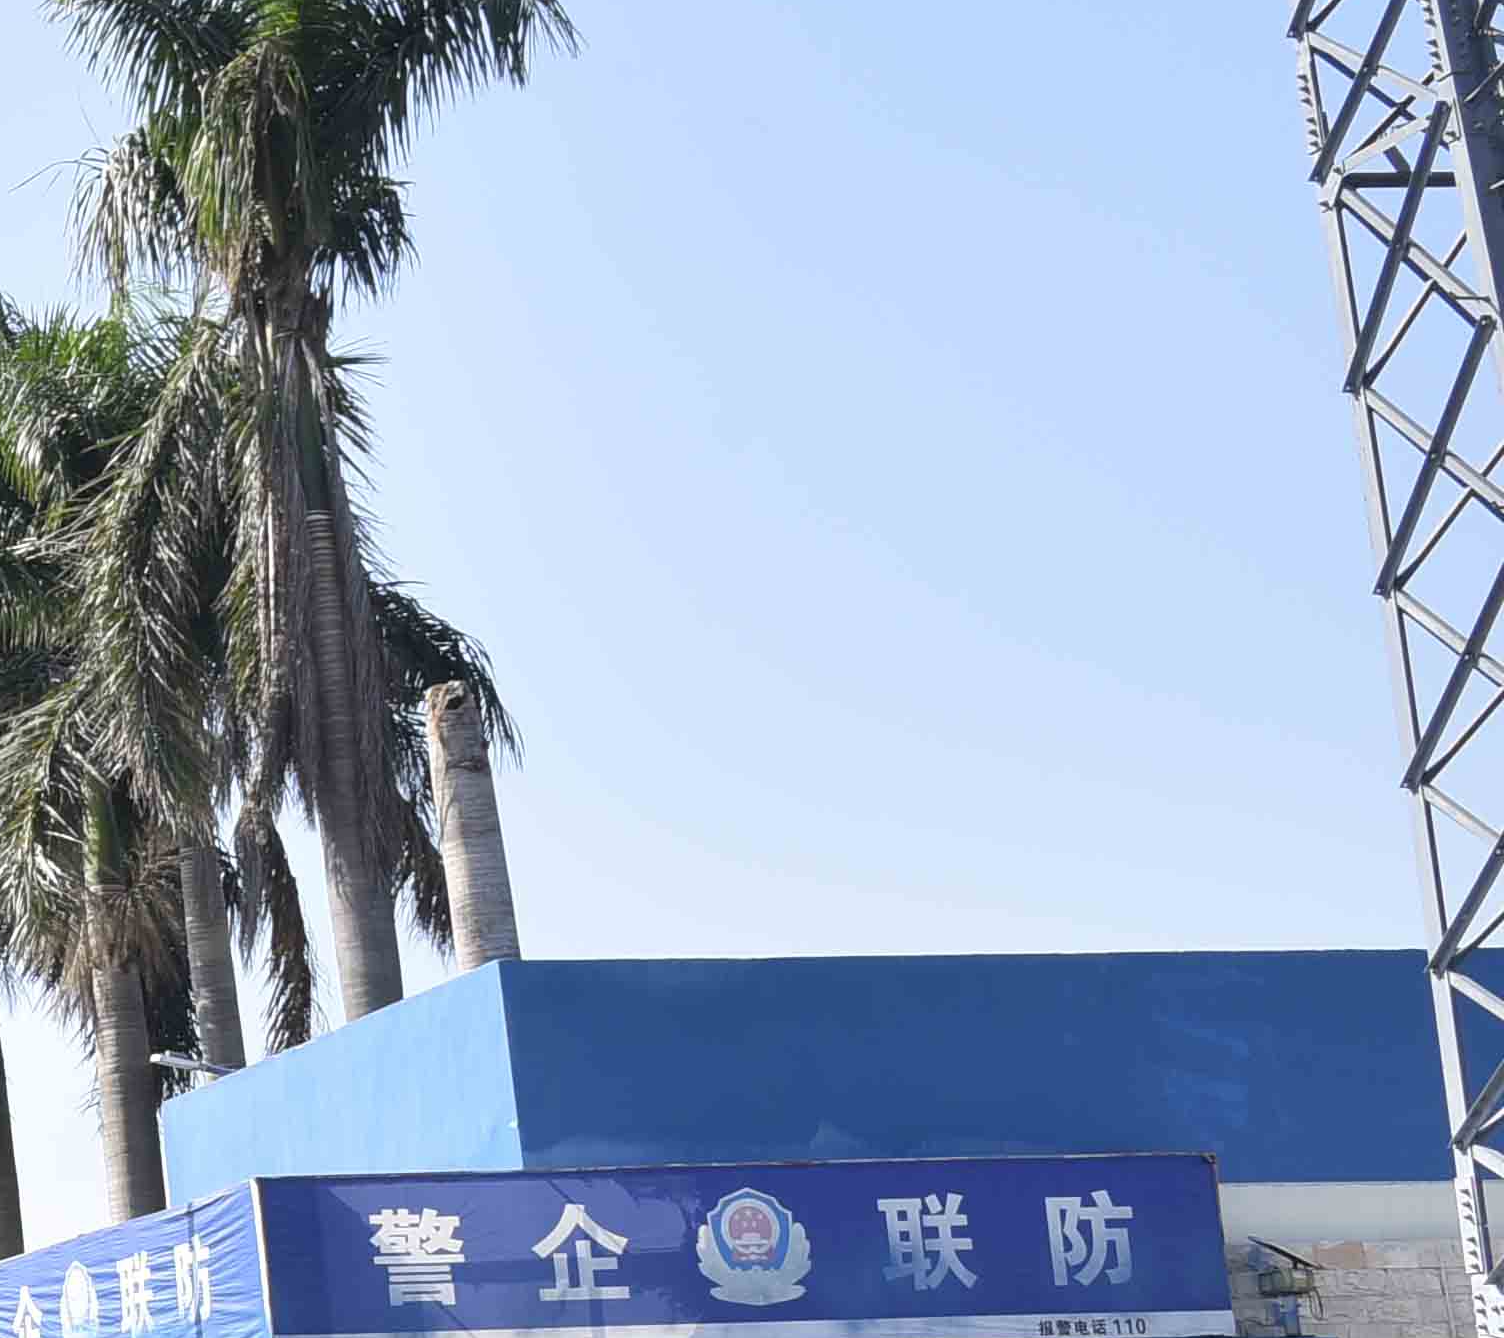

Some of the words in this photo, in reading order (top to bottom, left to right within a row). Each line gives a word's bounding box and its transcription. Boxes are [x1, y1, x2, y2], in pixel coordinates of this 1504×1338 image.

[368, 1203, 631, 1307] 警企
[876, 1190, 1134, 1291] 联防
[1039, 1318, 1107, 1336] 报警电话
[1112, 1317, 1147, 1335] 110
